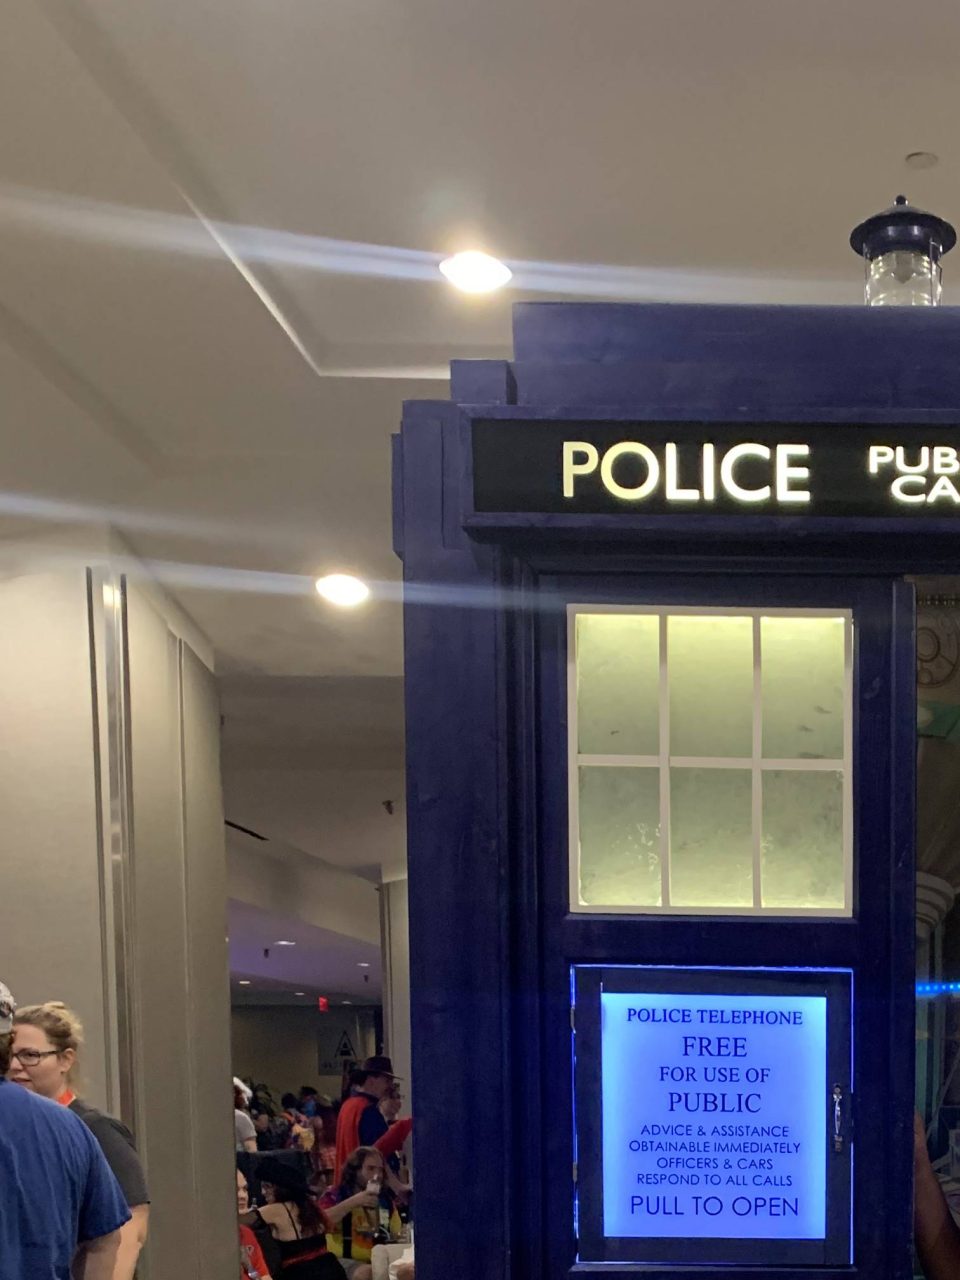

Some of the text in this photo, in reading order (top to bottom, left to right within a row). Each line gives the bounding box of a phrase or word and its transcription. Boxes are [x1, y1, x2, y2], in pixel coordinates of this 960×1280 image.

[561, 440, 812, 504] POLICE
[627, 1008, 803, 1025] POLICE TELEPHONE
[682, 1035, 748, 1058] FREE
[658, 1065, 771, 1084] FOR USE OF
[667, 1092, 762, 1114] PUBLIC
[639, 1123, 790, 1138] ADVICE & ASSISTANCE
[628, 1139, 801, 1155] OBTAINABLE IMMEDIATELY
[655, 1156, 774, 1171] OFFICERS & CARS
[636, 1173, 793, 1188] RESPOND TO ALL CALLS
[629, 1195, 800, 1218] PULL TO OPEN
